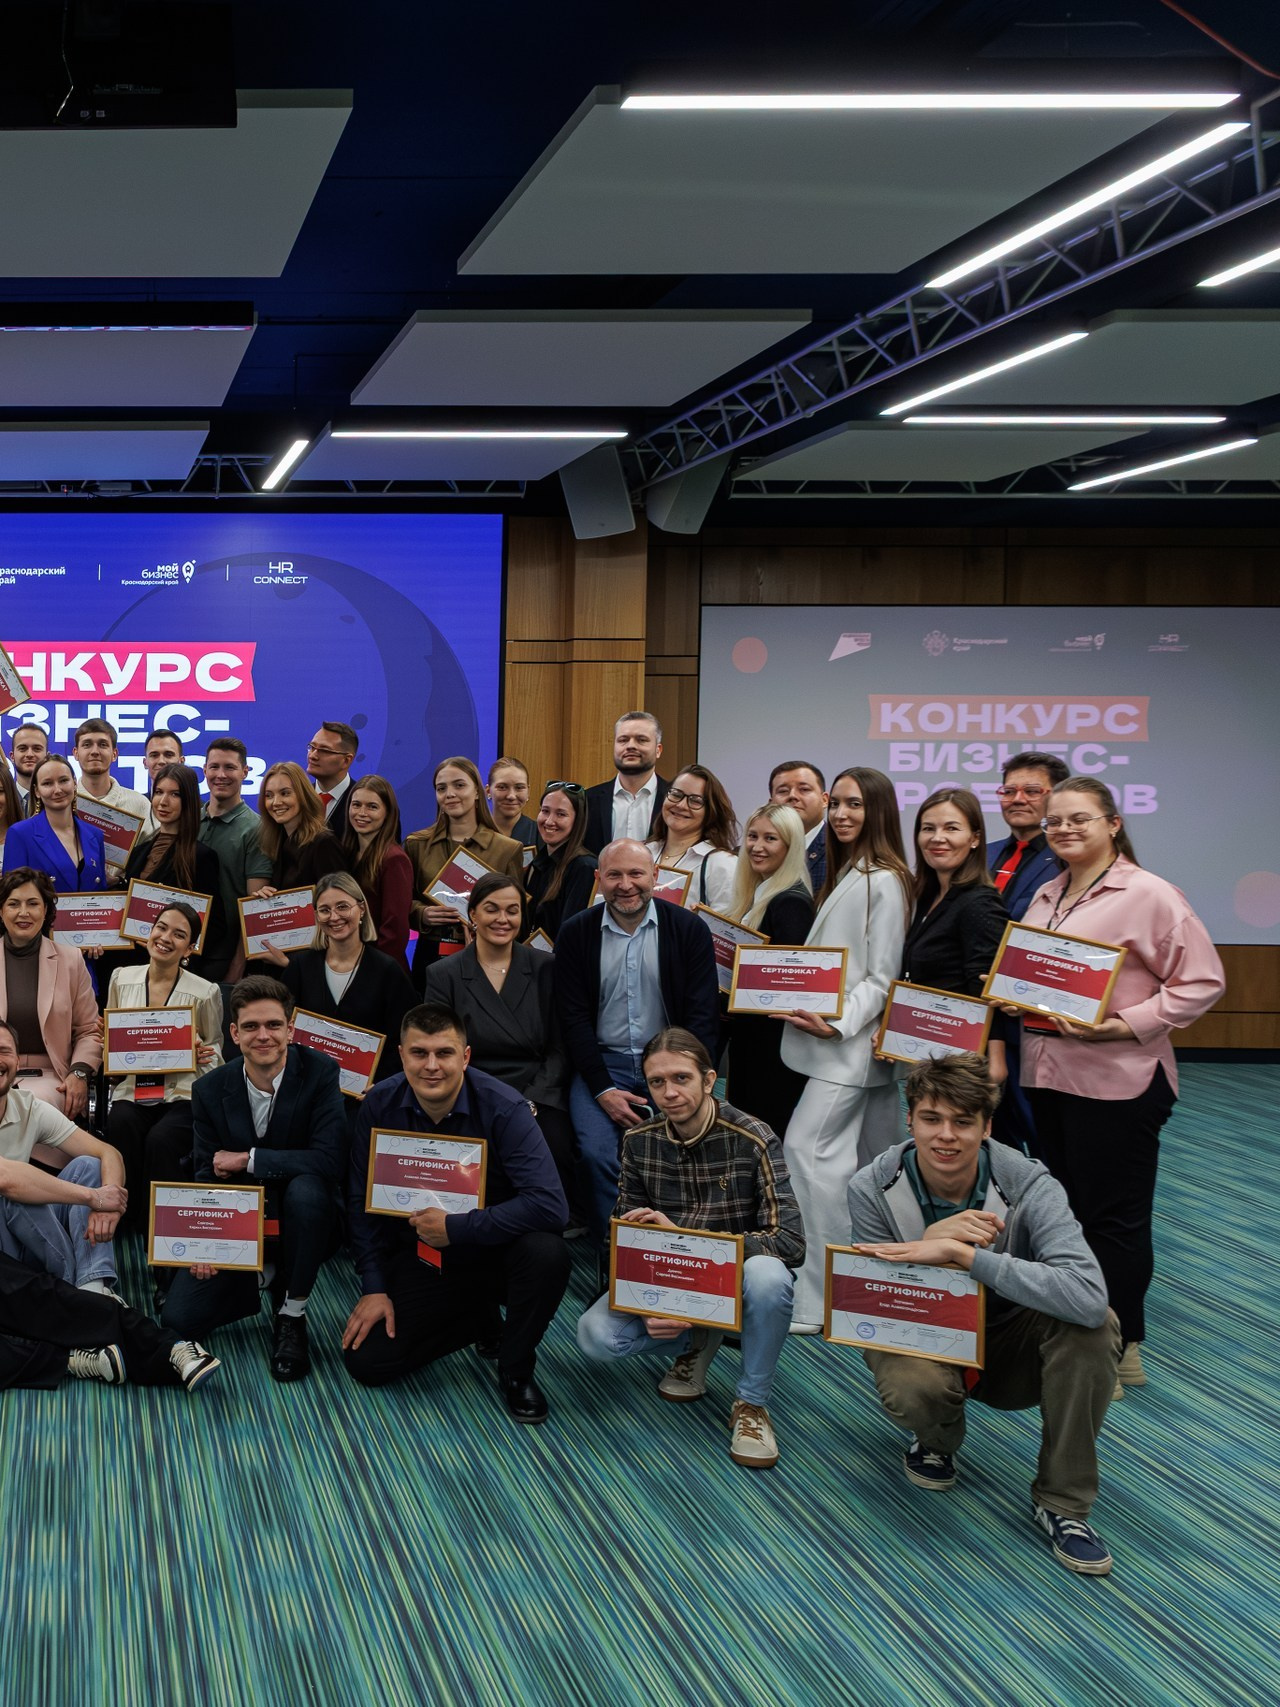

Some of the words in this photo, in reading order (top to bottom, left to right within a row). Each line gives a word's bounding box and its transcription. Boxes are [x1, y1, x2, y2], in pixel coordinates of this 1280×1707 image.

[157, 563, 179, 572] мой
[269, 562, 293, 574] HR
[141, 569, 179, 579] бизнес
[253, 576, 308, 584] CONNECT
[880, 702, 1140, 737] КОНКУРС
[888, 742, 1130, 775] БИЗС-
[70, 910, 111, 918] СЕРТИФИКАТ
[259, 908, 299, 920] СЕРТИФИКАТ
[1026, 953, 1086, 974] СЕРТИФИКАТ
[761, 967, 817, 975] СЕРТИФИКАТ
[912, 1010, 964, 1027] СЕРТИФИКАТ
[126, 1028, 173, 1036] СЕРТИФИКАТ
[309, 1035, 357, 1054] СЕРТИФИКАТ
[398, 1158, 456, 1171] СЕРТИФИКАТ
[177, 1209, 234, 1218] СЕРТИФИКАТ
[643, 1253, 708, 1270] СЕРТИФИКАТ
[865, 1282, 944, 1301] СЕРТИФИКАТ
